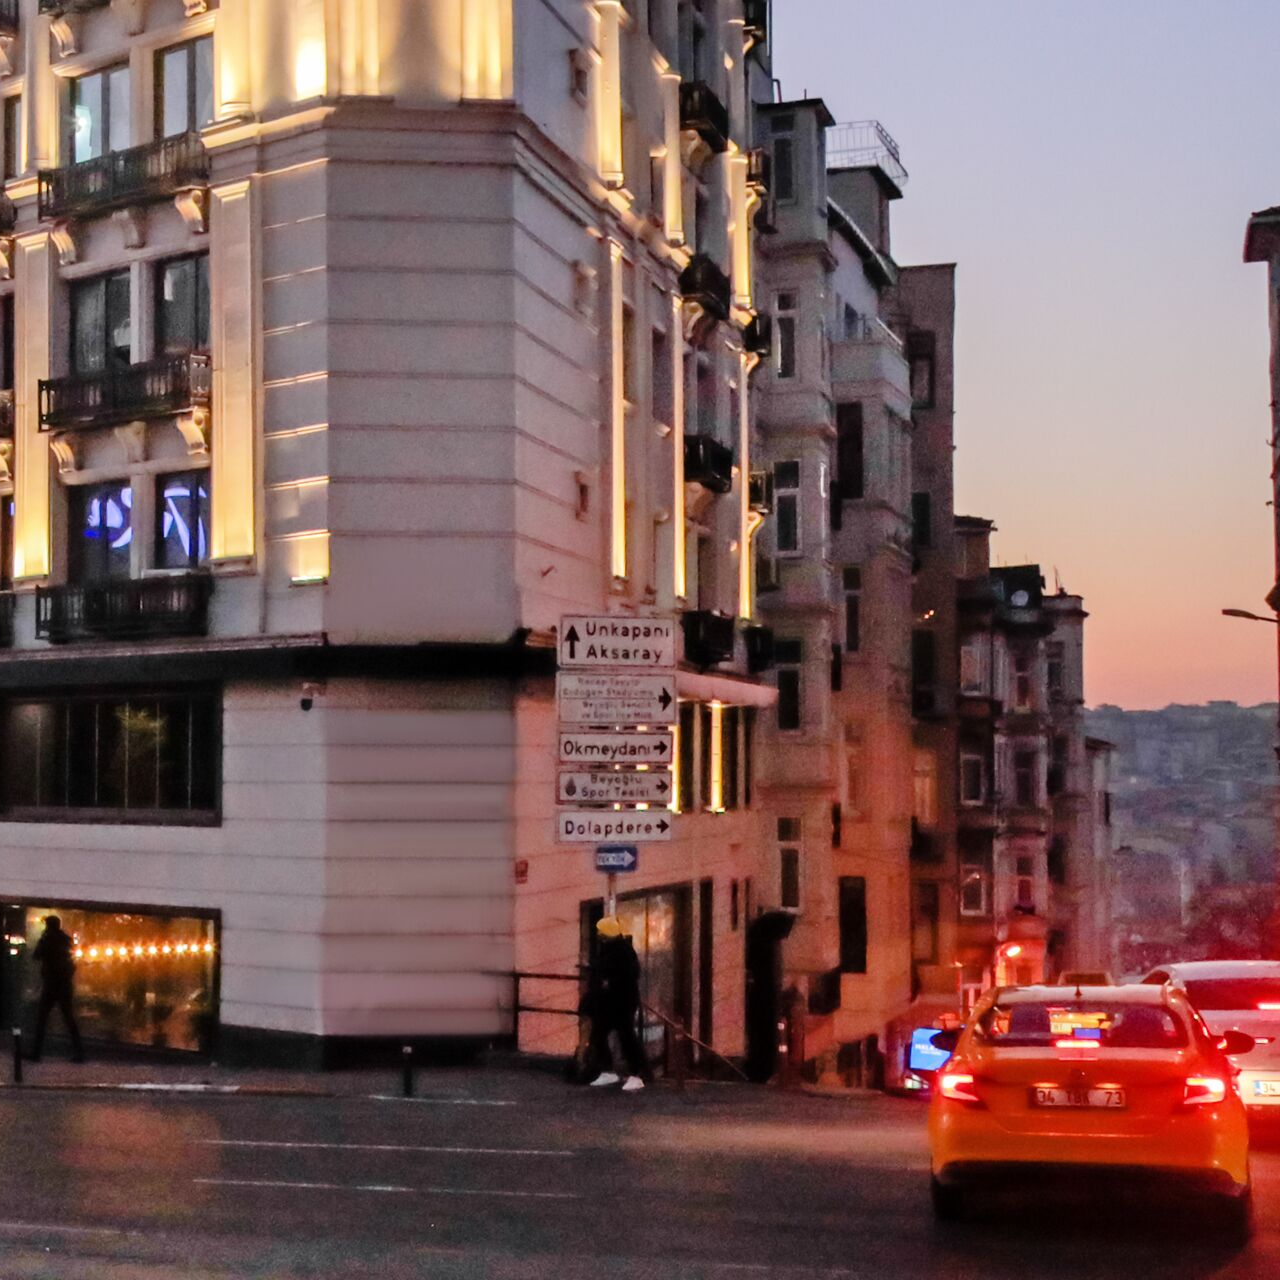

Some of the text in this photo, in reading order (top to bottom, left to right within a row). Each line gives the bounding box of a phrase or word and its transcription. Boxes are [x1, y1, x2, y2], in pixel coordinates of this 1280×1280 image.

[585, 621, 670, 641] Unkapanı
[586, 644, 663, 664] Aksaray
[563, 740, 651, 760] Okmeydanı
[590, 773, 643, 786] Beyoğlu
[581, 786, 610, 798] Spor
[564, 820, 653, 838] Dolapdere
[1038, 1090, 1056, 1104] 34
[1103, 1091, 1122, 1105] 73
